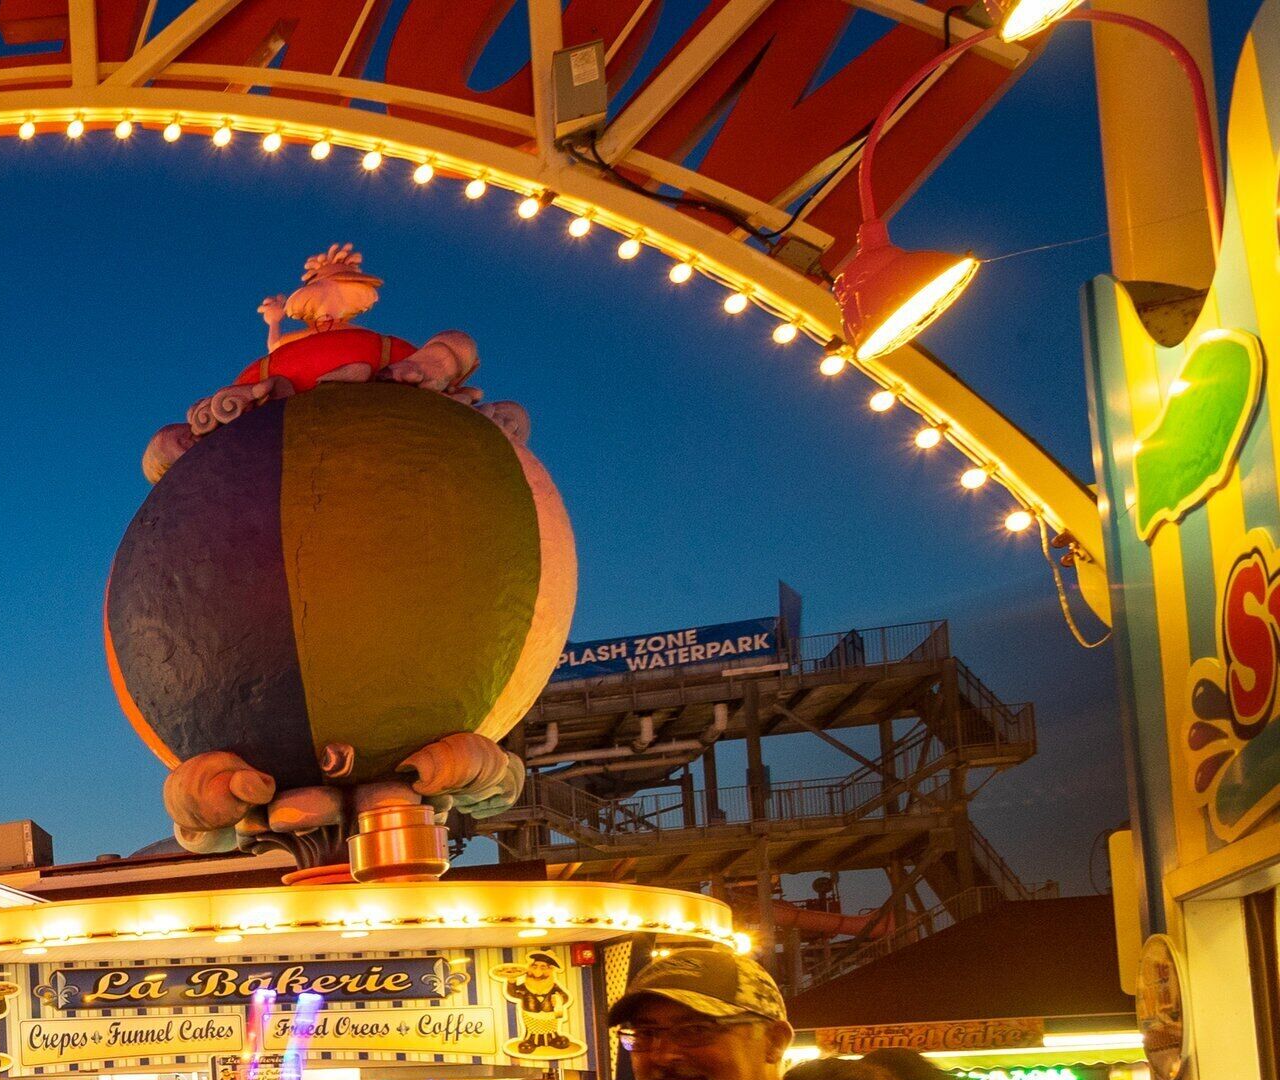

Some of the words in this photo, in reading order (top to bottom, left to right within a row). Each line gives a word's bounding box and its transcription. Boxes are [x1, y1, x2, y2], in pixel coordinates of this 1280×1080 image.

[557, 642, 627, 669] PLASH
[633, 629, 698, 655] ZONE
[625, 633, 771, 672] WATERPARK
[86, 971, 168, 1000] La
[186, 965, 413, 999] Bakerie
[29, 1024, 88, 1055] Crepes
[107, 1018, 172, 1046] Funnel
[179, 1018, 235, 1041] Cakes
[276, 1014, 328, 1037] Fried
[334, 1015, 391, 1037] Oreos
[418, 1014, 485, 1041] Coffee
[837, 1027, 936, 1054] Funnel
[943, 1024, 1023, 1048] Cake
